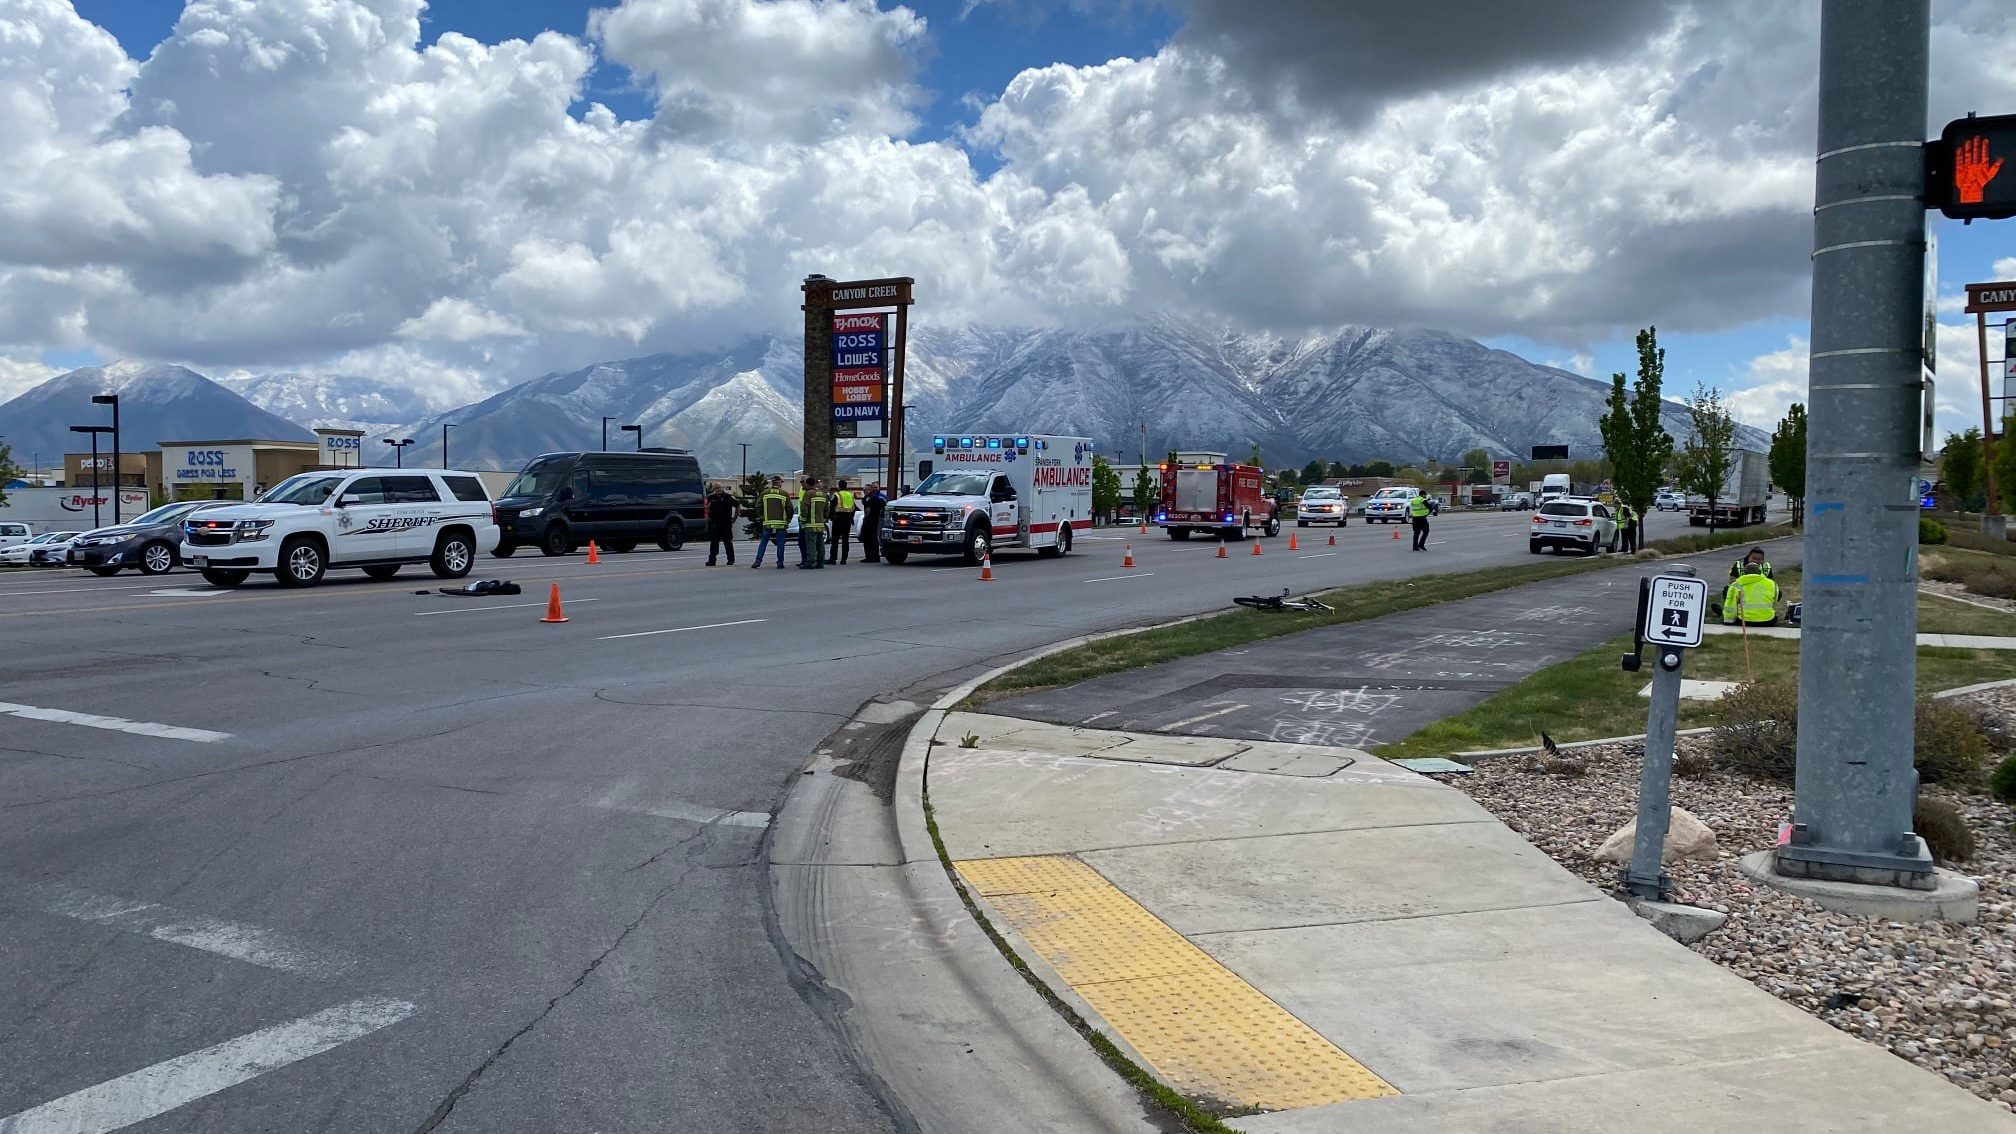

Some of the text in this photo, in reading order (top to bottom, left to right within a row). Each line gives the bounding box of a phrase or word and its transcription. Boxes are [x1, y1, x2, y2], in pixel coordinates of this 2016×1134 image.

[832, 285, 897, 301] CANYON CREEK
[838, 333, 876, 348] ROSS
[837, 351, 878, 366] LOWE'S
[835, 371, 880, 383] HomeGoods
[842, 386, 869, 394] HOBBY
[846, 393, 872, 401] LOBBY
[835, 406, 880, 417] OLD NAVY
[328, 437, 360, 449] ROSS
[188, 450, 223, 466] ROSS
[945, 453, 1002, 462] AMBULANCE
[176, 468, 237, 478] DRESS FOR LESS
[1033, 467, 1090, 487] AMBULANCE
[71, 494, 109, 508] Ryder
[125, 494, 144, 502] Ryder
[366, 516, 438, 530] SHERIFF
[1668, 582, 1690, 591] PUSH
[1662, 590, 1694, 600] BUTTON
[1669, 599, 1685, 608] FOR
